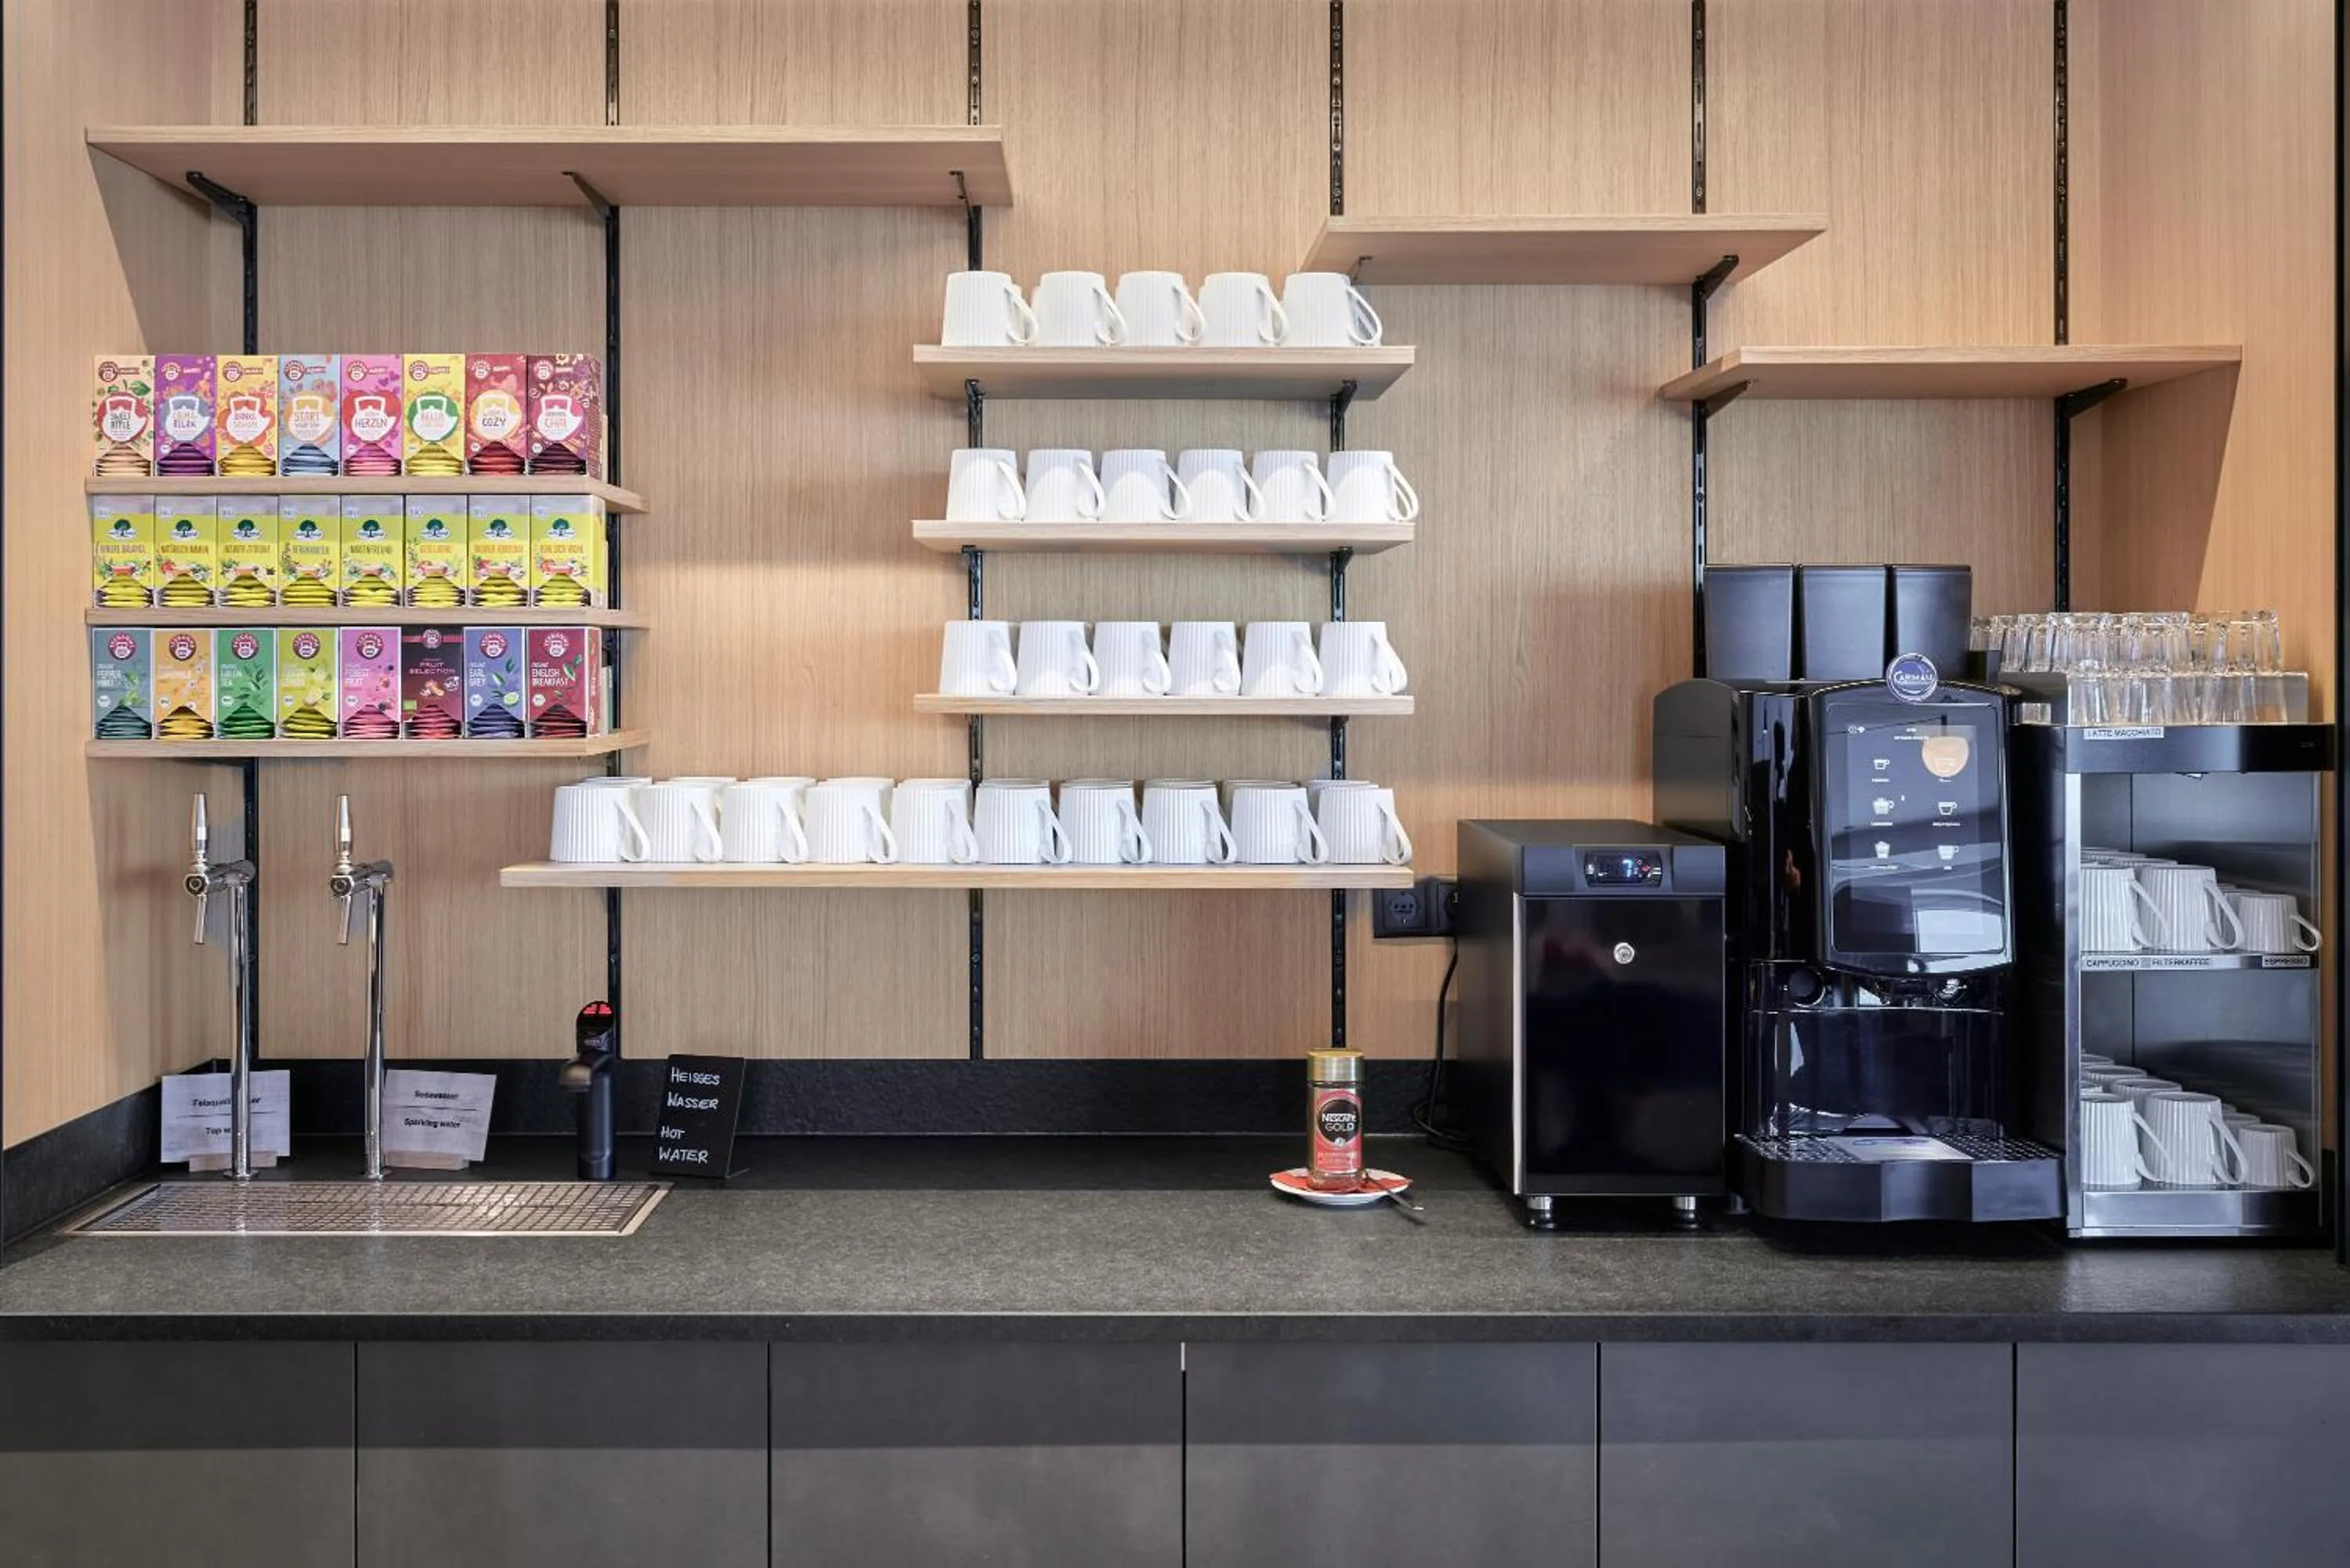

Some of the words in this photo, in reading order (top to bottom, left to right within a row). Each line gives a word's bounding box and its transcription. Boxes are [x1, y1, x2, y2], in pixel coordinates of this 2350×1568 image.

[532, 668, 559, 677] ENGLISH
[532, 677, 569, 687] BREAKFAST
[671, 1067, 721, 1086] HEISSES
[667, 1091, 719, 1110] WASSER
[660, 1125, 686, 1140] HOT
[1325, 1122, 1354, 1132] GOLD
[658, 1146, 709, 1165] WATER
